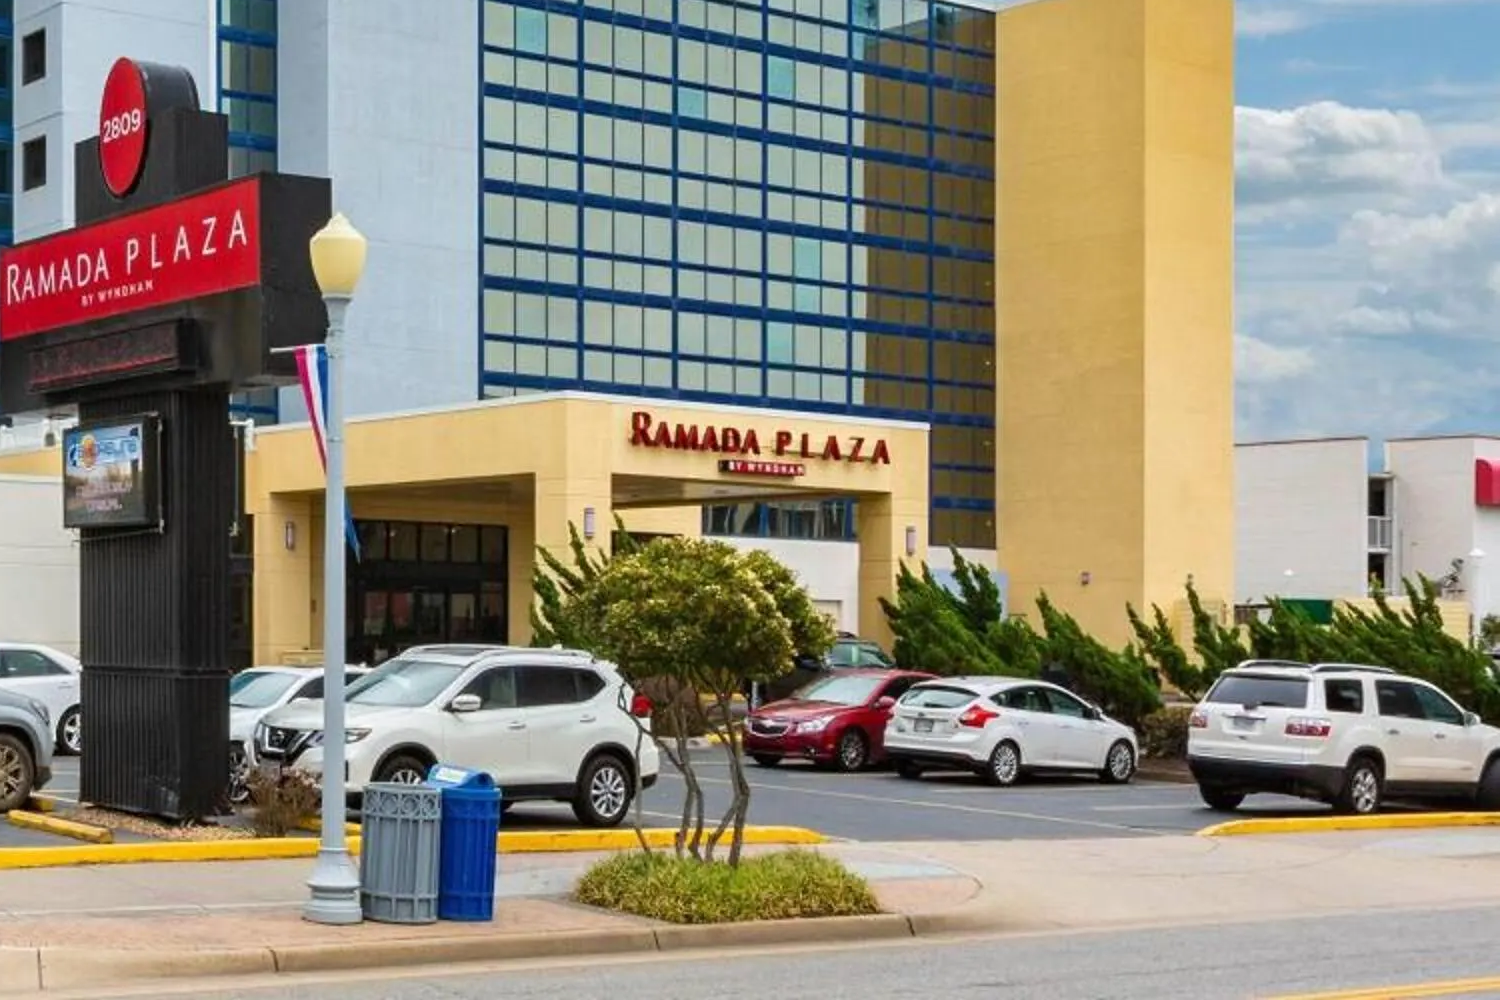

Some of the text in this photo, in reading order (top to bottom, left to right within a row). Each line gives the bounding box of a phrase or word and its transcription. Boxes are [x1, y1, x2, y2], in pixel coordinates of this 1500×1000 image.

[102, 108, 141, 143] 2809
[6, 209, 248, 305] RAMADA PLAZA
[81, 279, 153, 307] BY WYNDHAM
[630, 411, 891, 464] RAMADA PLAZA
[728, 461, 804, 475] BY WYNDHAM
